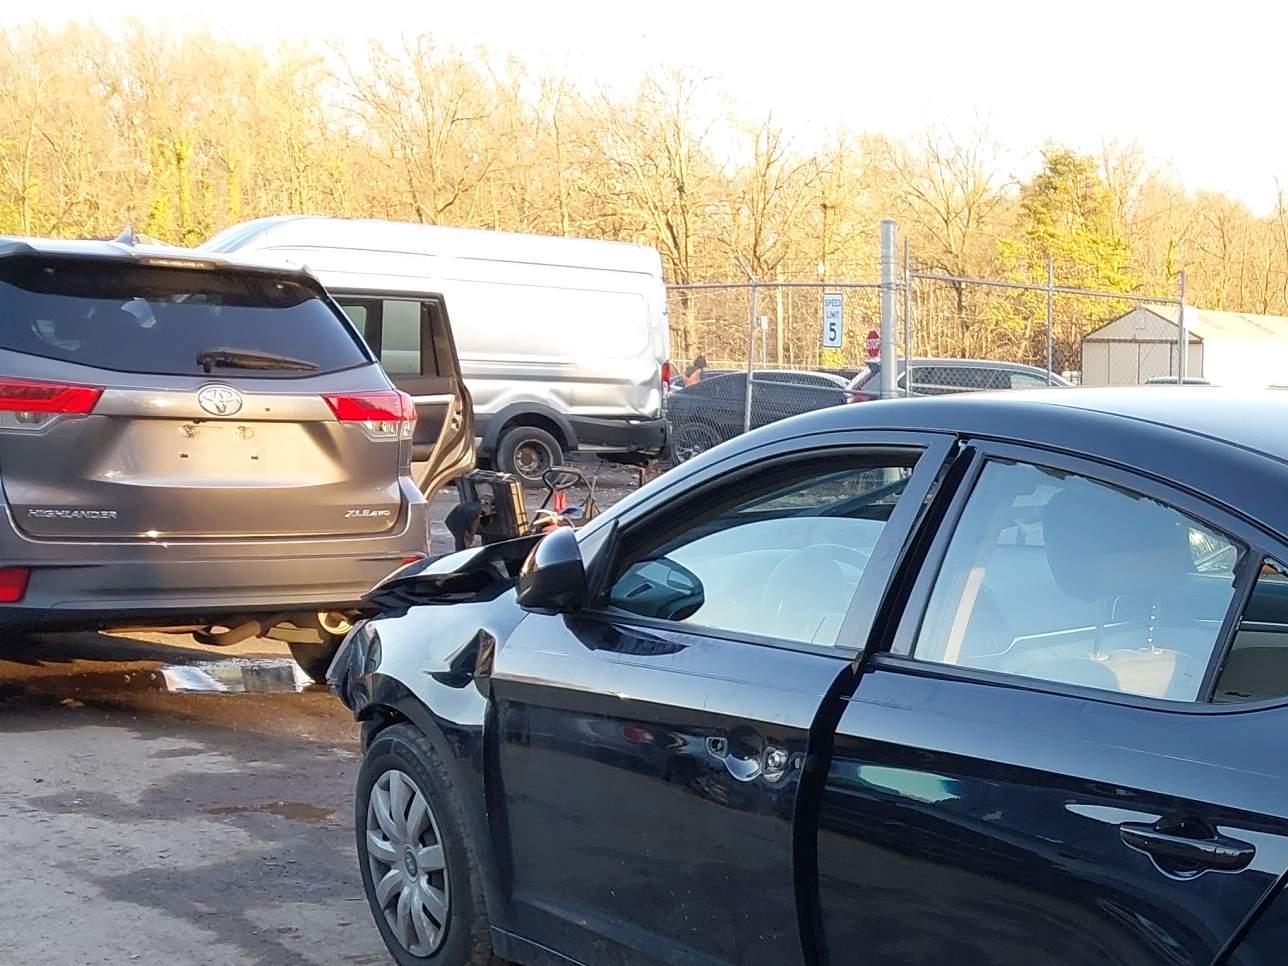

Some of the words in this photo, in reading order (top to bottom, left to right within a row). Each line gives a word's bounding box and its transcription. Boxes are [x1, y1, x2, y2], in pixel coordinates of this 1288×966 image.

[825, 298, 841, 307] SPEED
[826, 310, 840, 319] LIMIT
[829, 322, 837, 342] 5
[28, 509, 118, 520] HIGHLANDER
